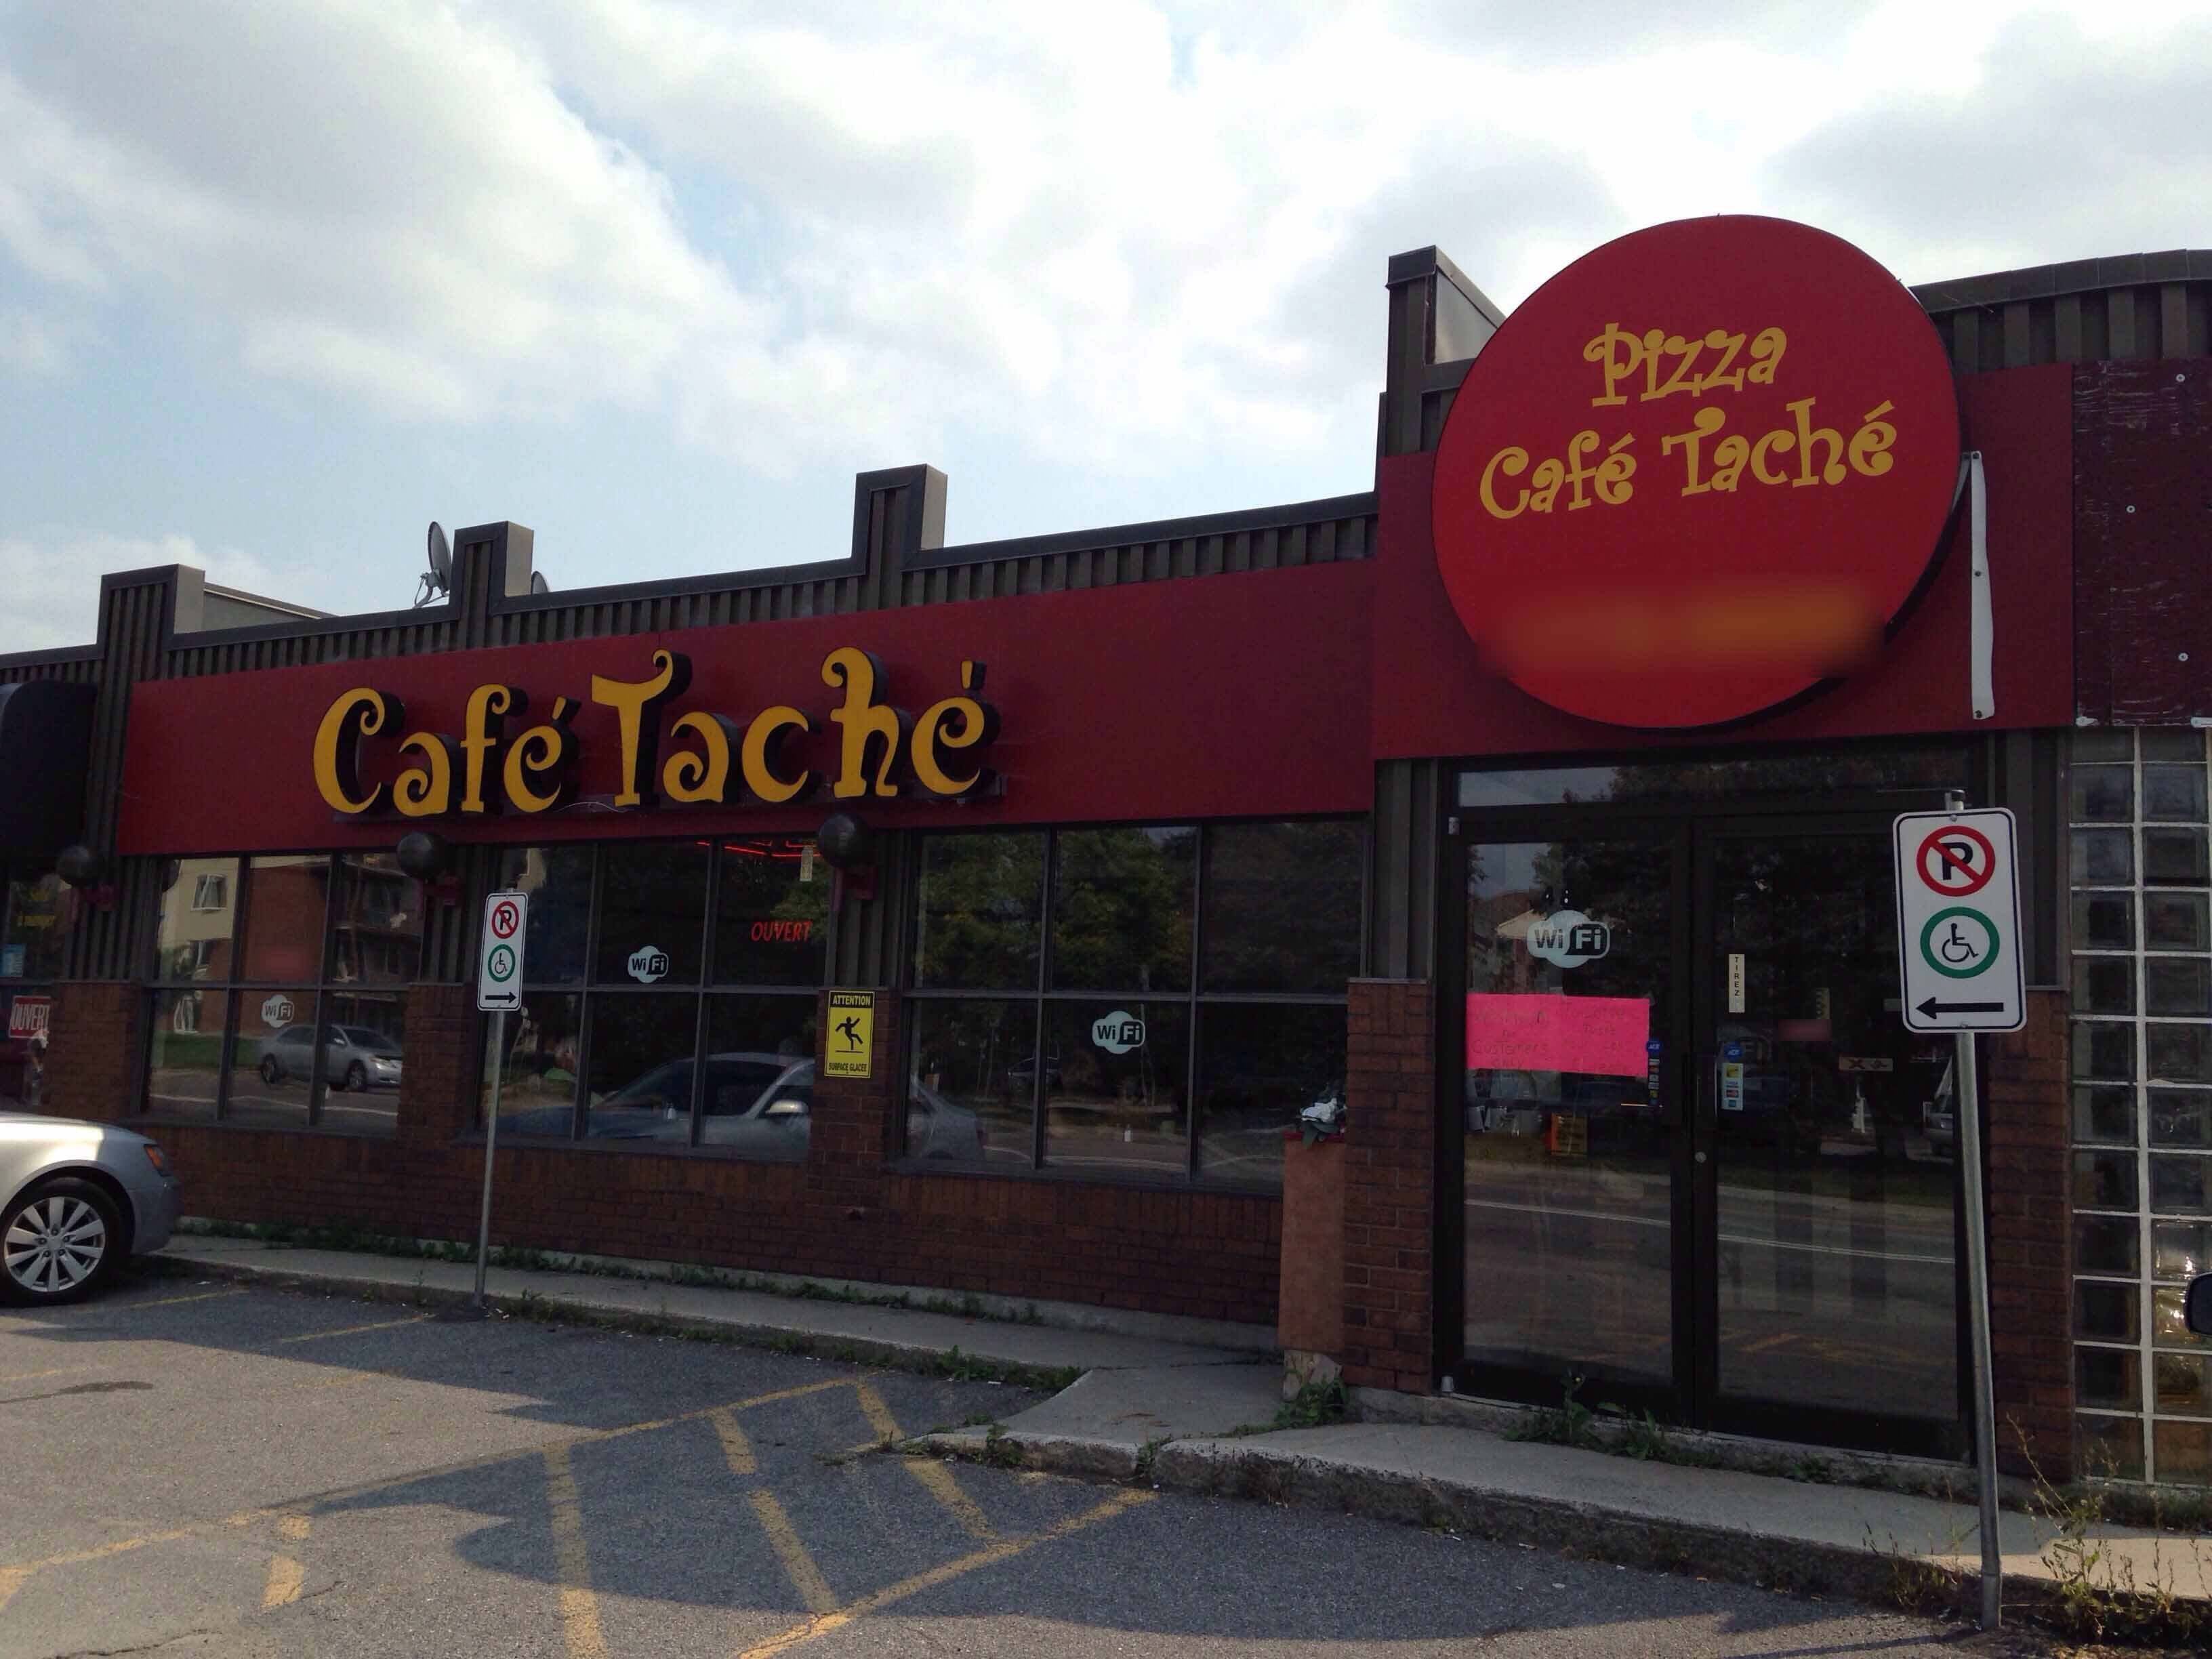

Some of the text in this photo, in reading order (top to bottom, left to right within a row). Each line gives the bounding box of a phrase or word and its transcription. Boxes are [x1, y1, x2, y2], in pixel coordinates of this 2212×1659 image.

[1583, 323, 1787, 407] Pizza
[1479, 397, 1897, 519] Café Taché
[313, 649, 985, 817] Café Taché
[751, 921, 812, 942] OUVERT
[832, 995, 871, 1006] ATTENTION
[11, 1003, 50, 1031] OUVERT
[829, 1062, 848, 1071] SURFACE
